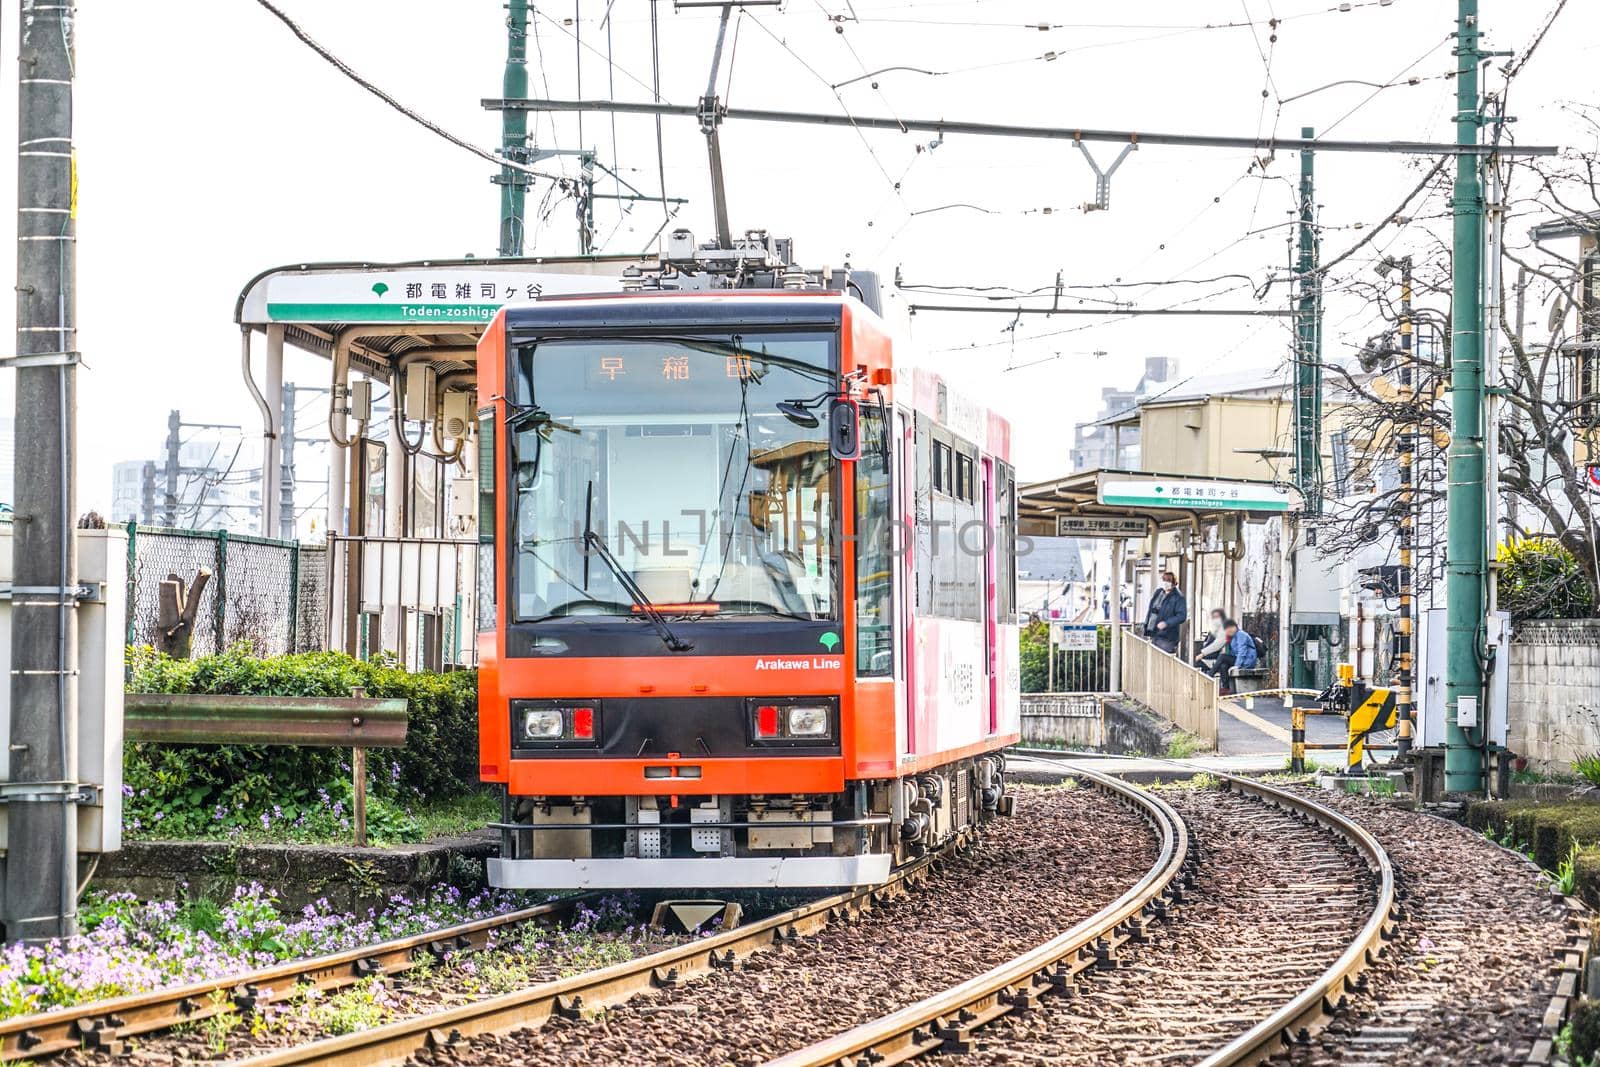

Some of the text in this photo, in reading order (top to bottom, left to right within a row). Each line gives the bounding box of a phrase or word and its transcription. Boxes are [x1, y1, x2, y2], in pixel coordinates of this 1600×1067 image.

[600, 356, 751, 380] 早稲田
[756, 658, 841, 670] Arakawa Line
